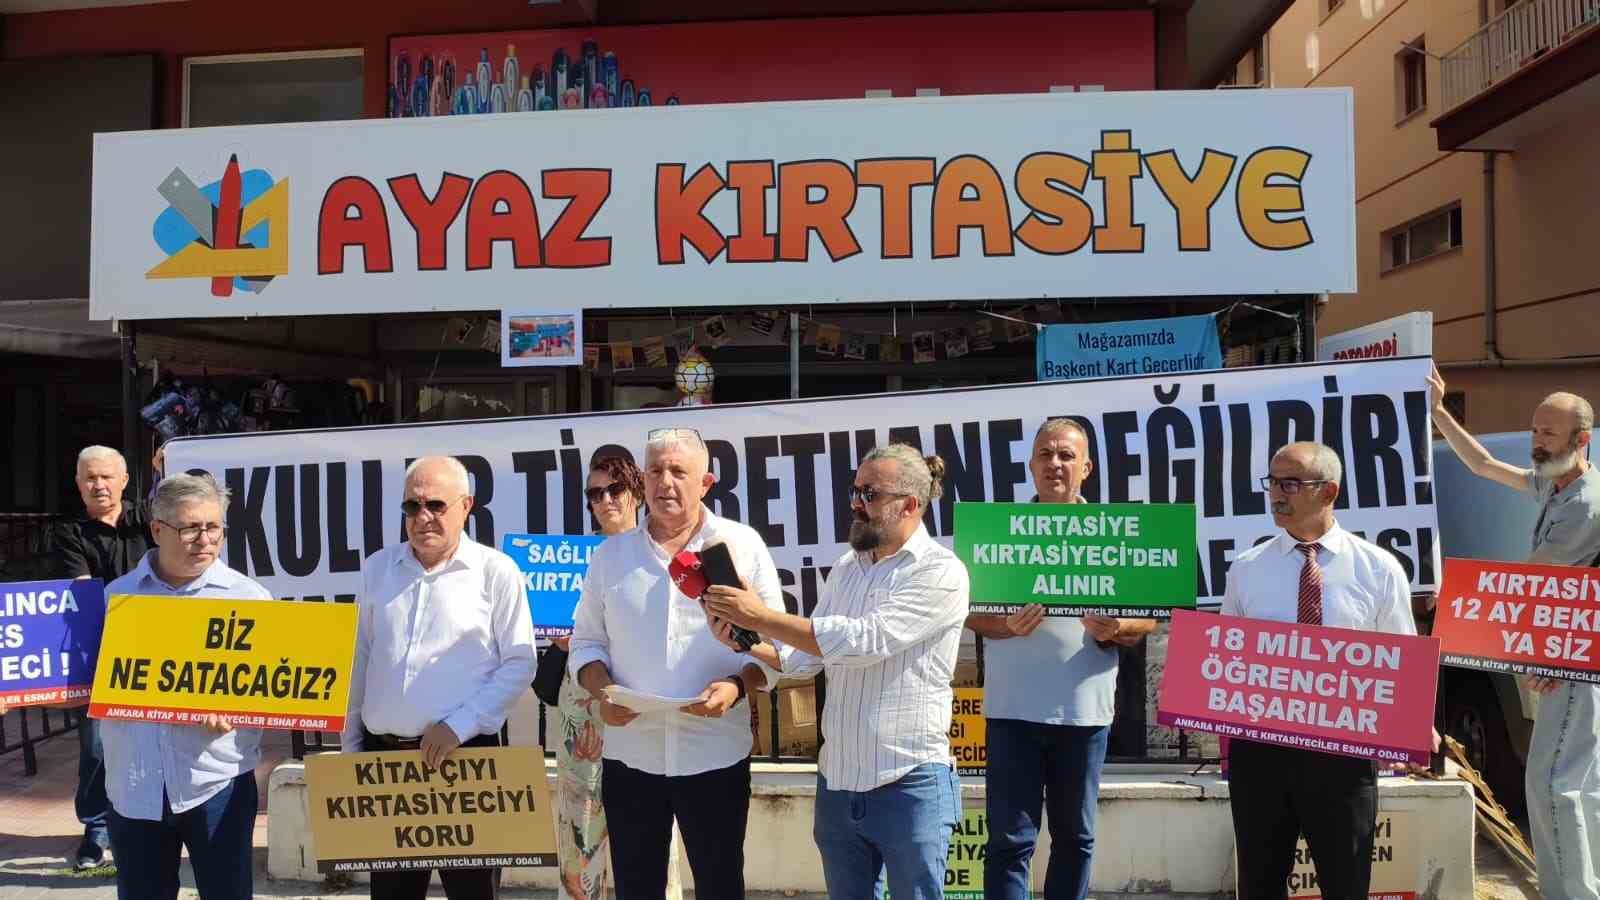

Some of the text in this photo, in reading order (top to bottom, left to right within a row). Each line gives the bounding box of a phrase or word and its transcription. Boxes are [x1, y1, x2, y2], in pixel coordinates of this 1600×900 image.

[317, 129, 1314, 275] AYAZ KIRTASİYE
[1078, 328, 1175, 351] Mağazamızda
[1045, 359, 1101, 379] Başkent
[1106, 358, 1142, 376] Kart
[1010, 511, 1140, 537] KIRTASİYE
[527, 540, 598, 565] SAĞLI
[973, 540, 1178, 567] KIRTASİYECİ'DEN
[1032, 574, 1116, 596] ALINIR
[1451, 597, 1482, 620] 12
[1488, 601, 1526, 624] AY
[205, 610, 255, 651] BİZ
[1205, 625, 1401, 670] 18 MİLYON
[1502, 630, 1593, 662] YA SİZ
[1444, 655, 1481, 667] ANKARA
[1512, 664, 1524, 673] VE
[109, 657, 337, 701] NE SATACAĞIZ?
[1201, 652, 1396, 705] ÖĞRENCİYE
[106, 708, 144, 718] ANKARA
[176, 712, 189, 720] VE
[1207, 687, 1379, 735] BAŞARILAR
[1174, 718, 1213, 732] ANKARA
[1215, 723, 1243, 736] KİTAP
[1245, 729, 1258, 739] VE
[1260, 731, 1340, 752] KIRTASİYECİLER
[1342, 744, 1376, 757] ESNAF
[326, 784, 536, 819] KIRTASİYECİYİ
[394, 824, 475, 849] KORU
[400, 861, 411, 869] VE
